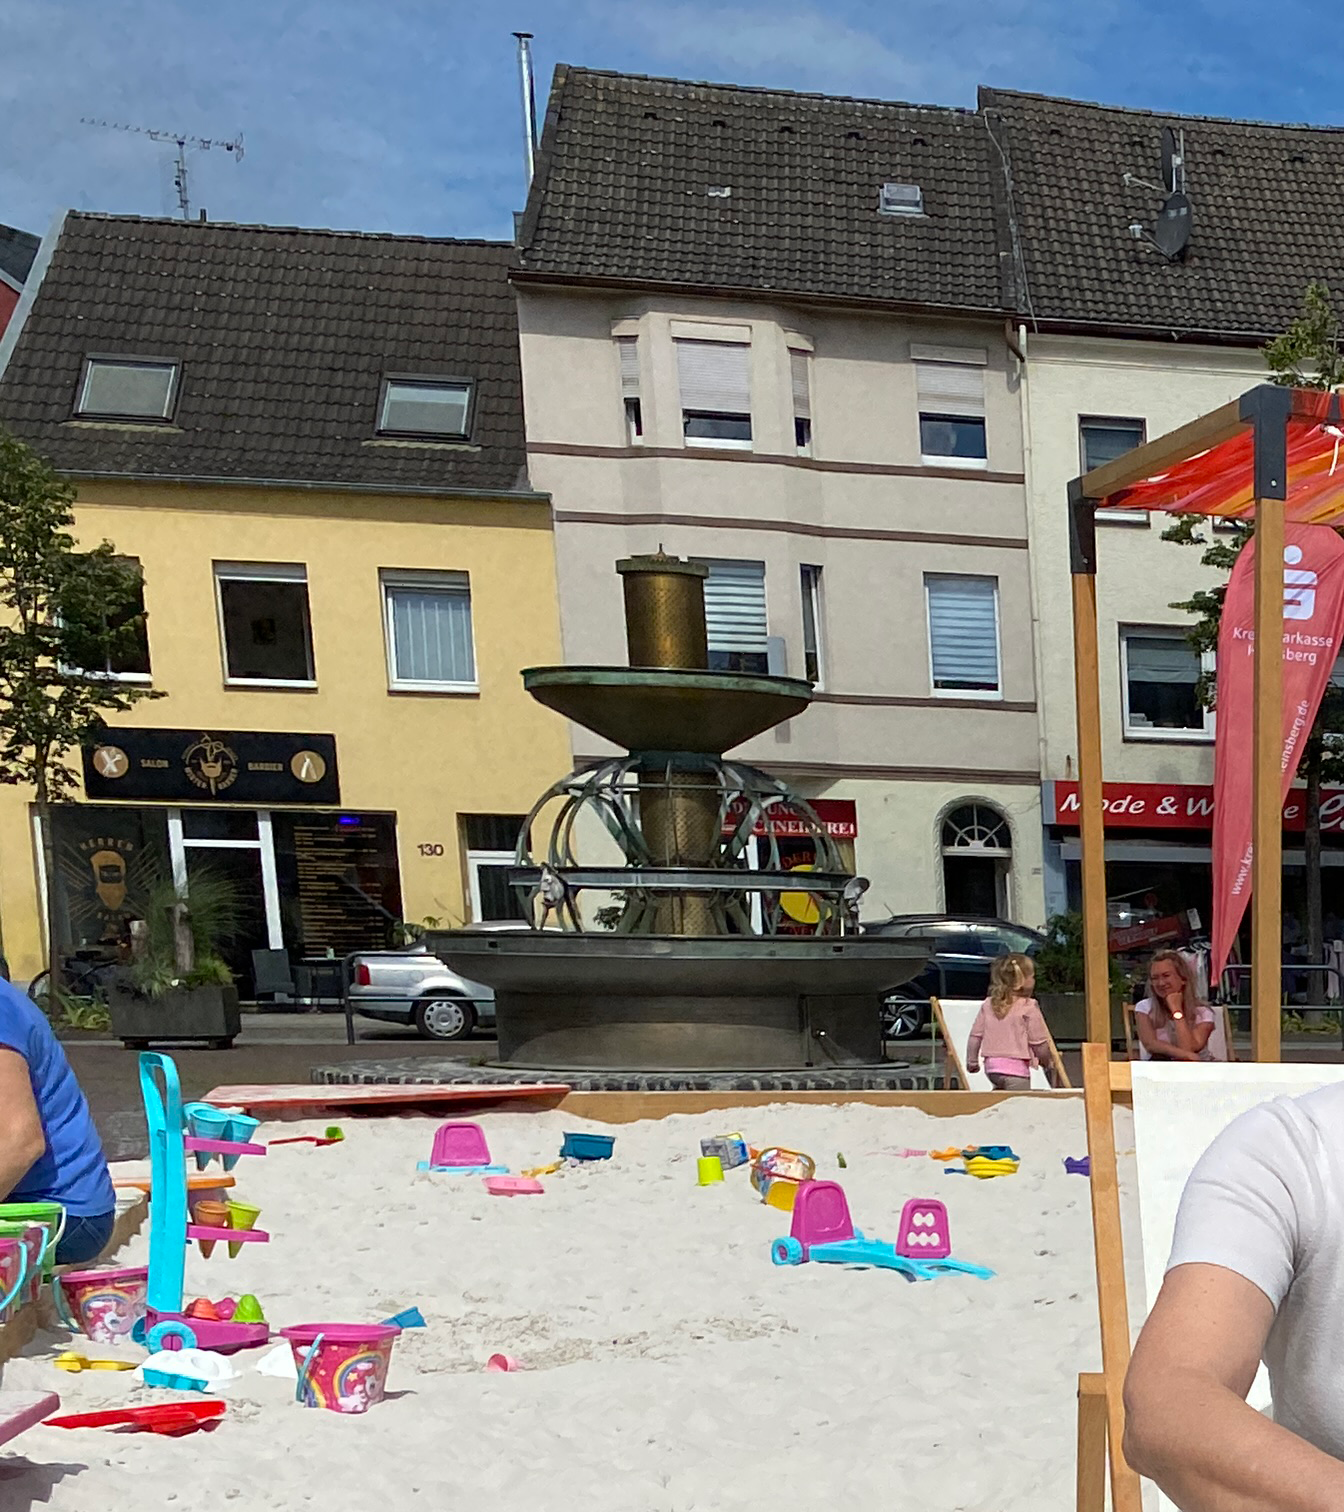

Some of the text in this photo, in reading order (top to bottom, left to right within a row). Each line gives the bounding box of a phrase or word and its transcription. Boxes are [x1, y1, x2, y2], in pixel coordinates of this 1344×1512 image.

[1232, 627, 1334, 648] Krearkasse
[1155, 795, 1178, 815] &
[416, 843, 445, 857] 130
